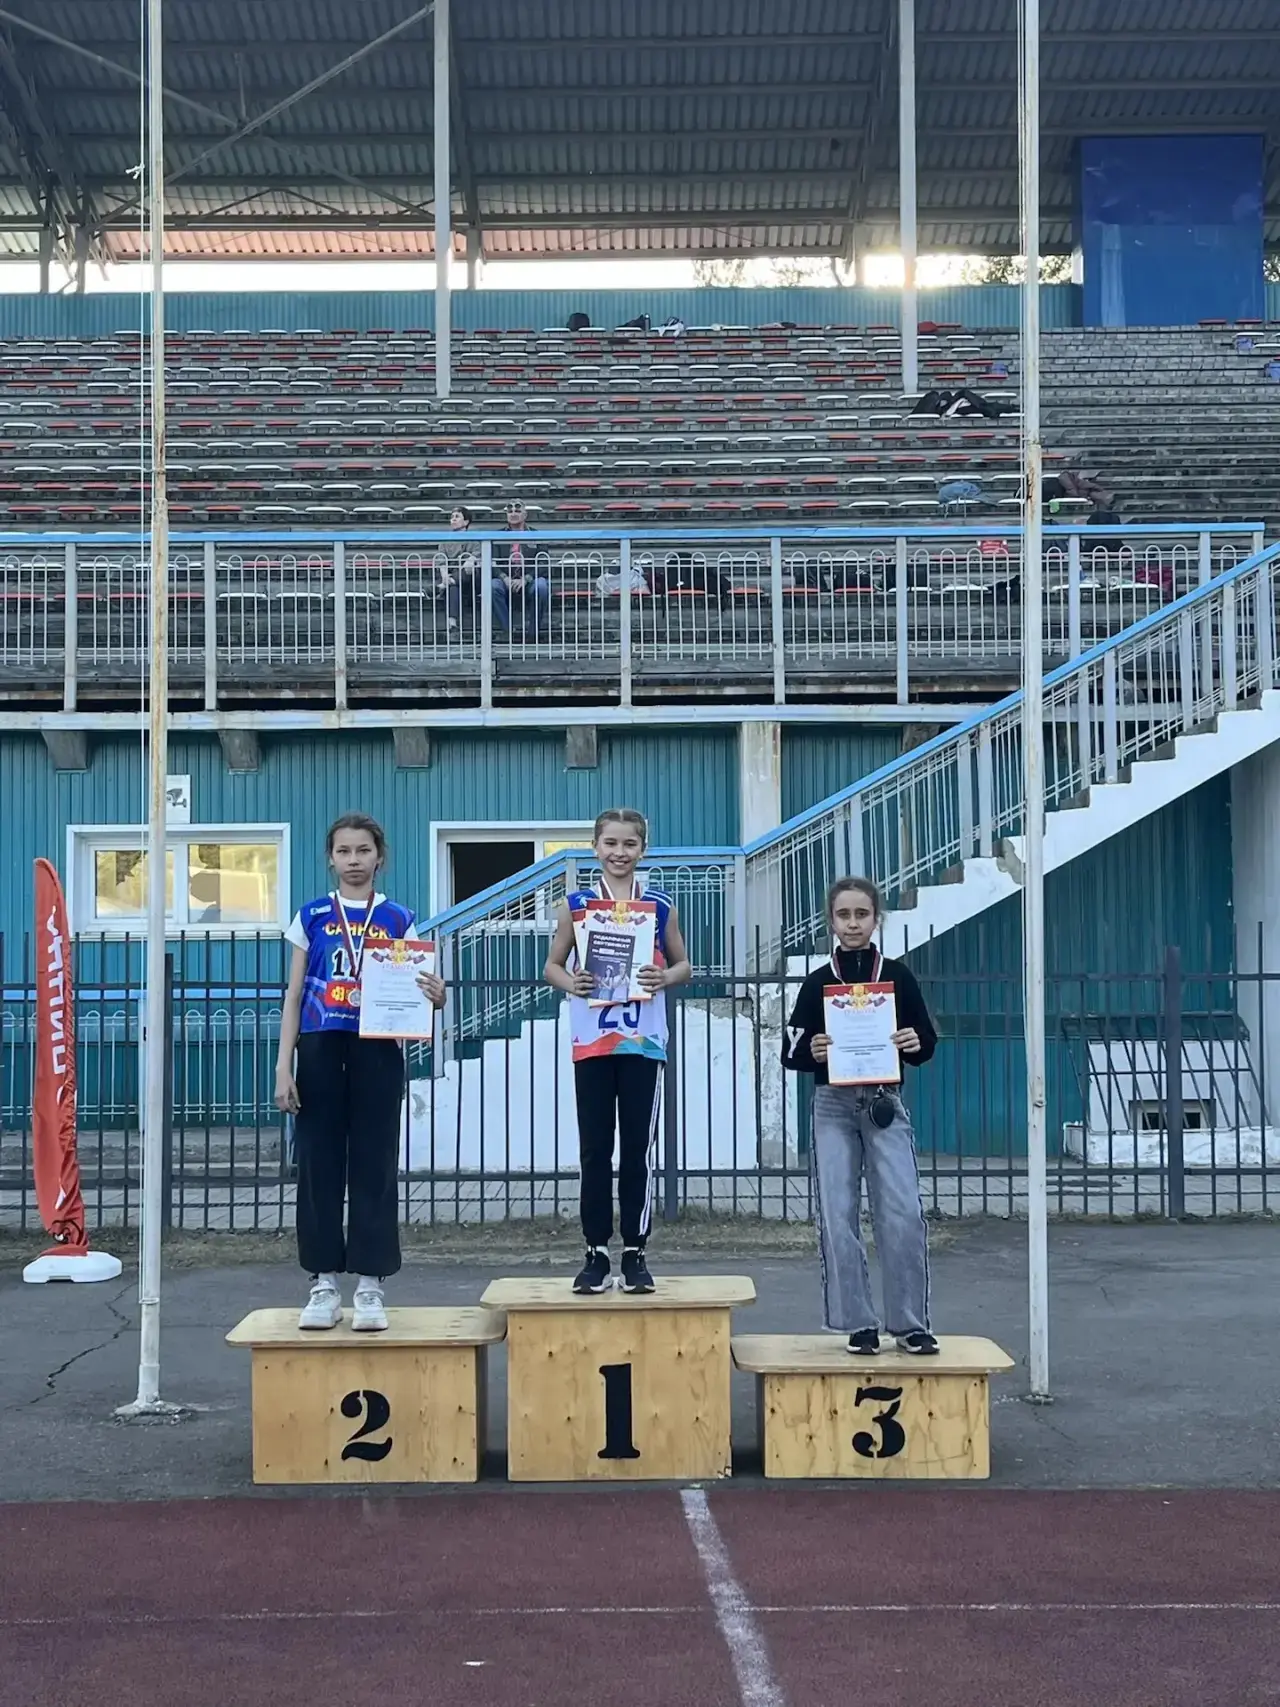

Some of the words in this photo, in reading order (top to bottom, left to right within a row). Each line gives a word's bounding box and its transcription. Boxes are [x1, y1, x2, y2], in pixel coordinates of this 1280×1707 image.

[341, 1389, 393, 1462] 2
[597, 1363, 641, 1459] 1
[852, 1386, 906, 1459] 3
